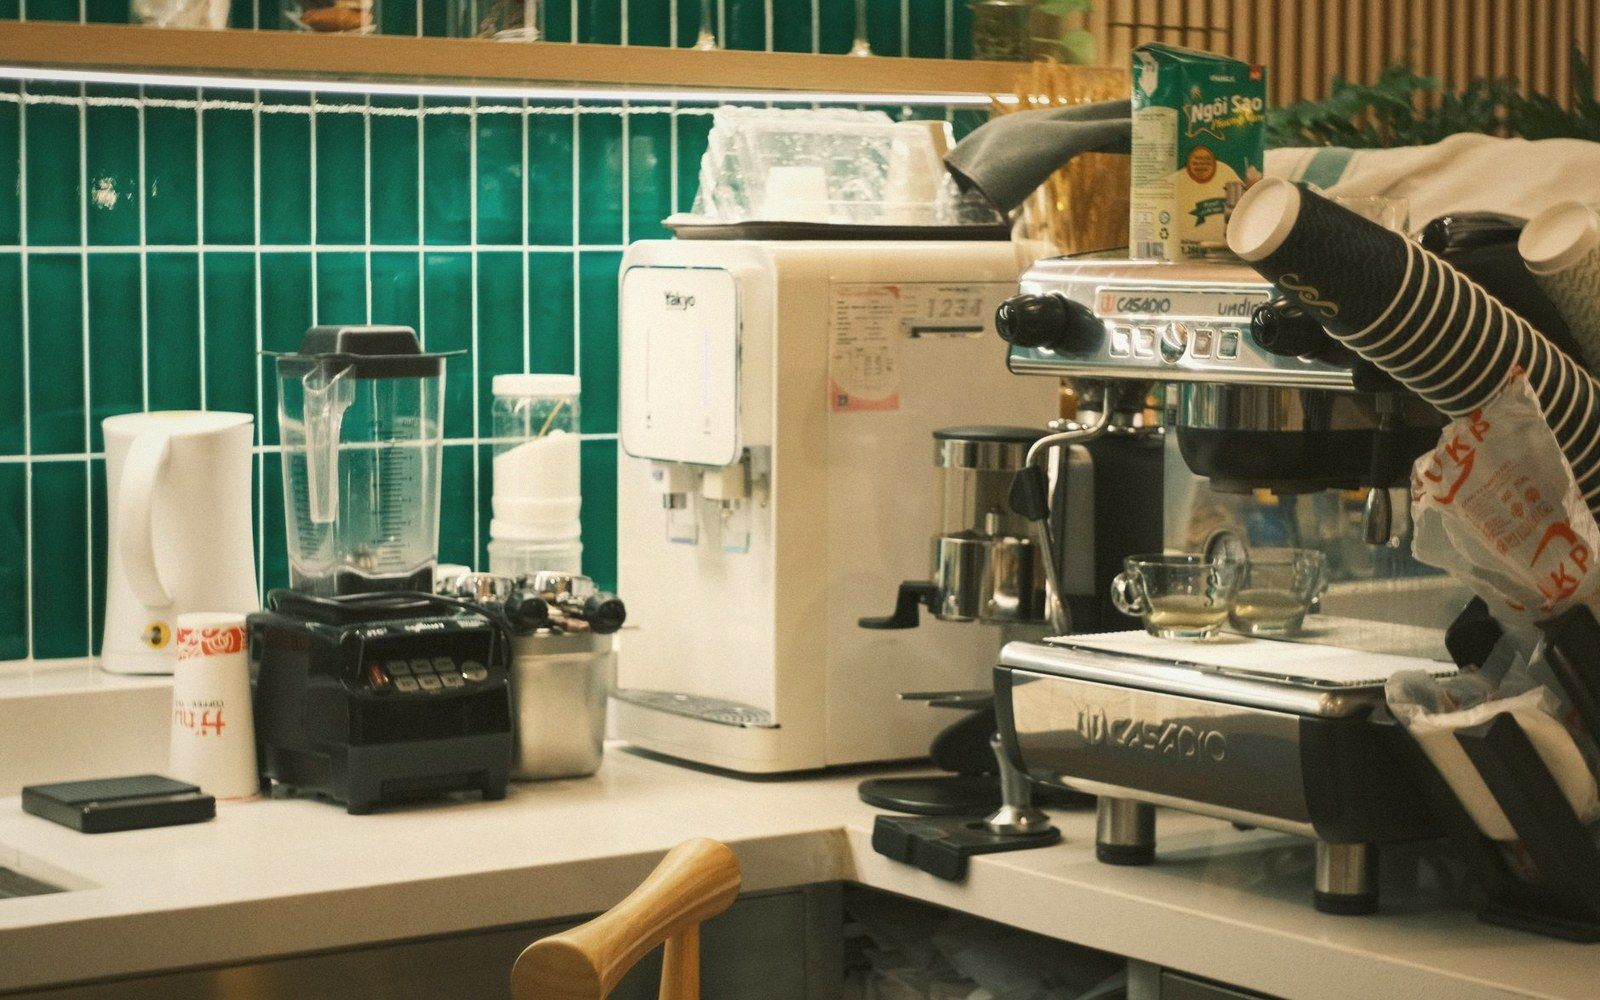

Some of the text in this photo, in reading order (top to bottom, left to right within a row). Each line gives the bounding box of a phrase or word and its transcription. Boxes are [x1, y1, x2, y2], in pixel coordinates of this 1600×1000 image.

[1191, 96, 1228, 123] Ngôi
[1116, 297, 1171, 314] CASADIO
[1111, 718, 1227, 762] CASADIO
